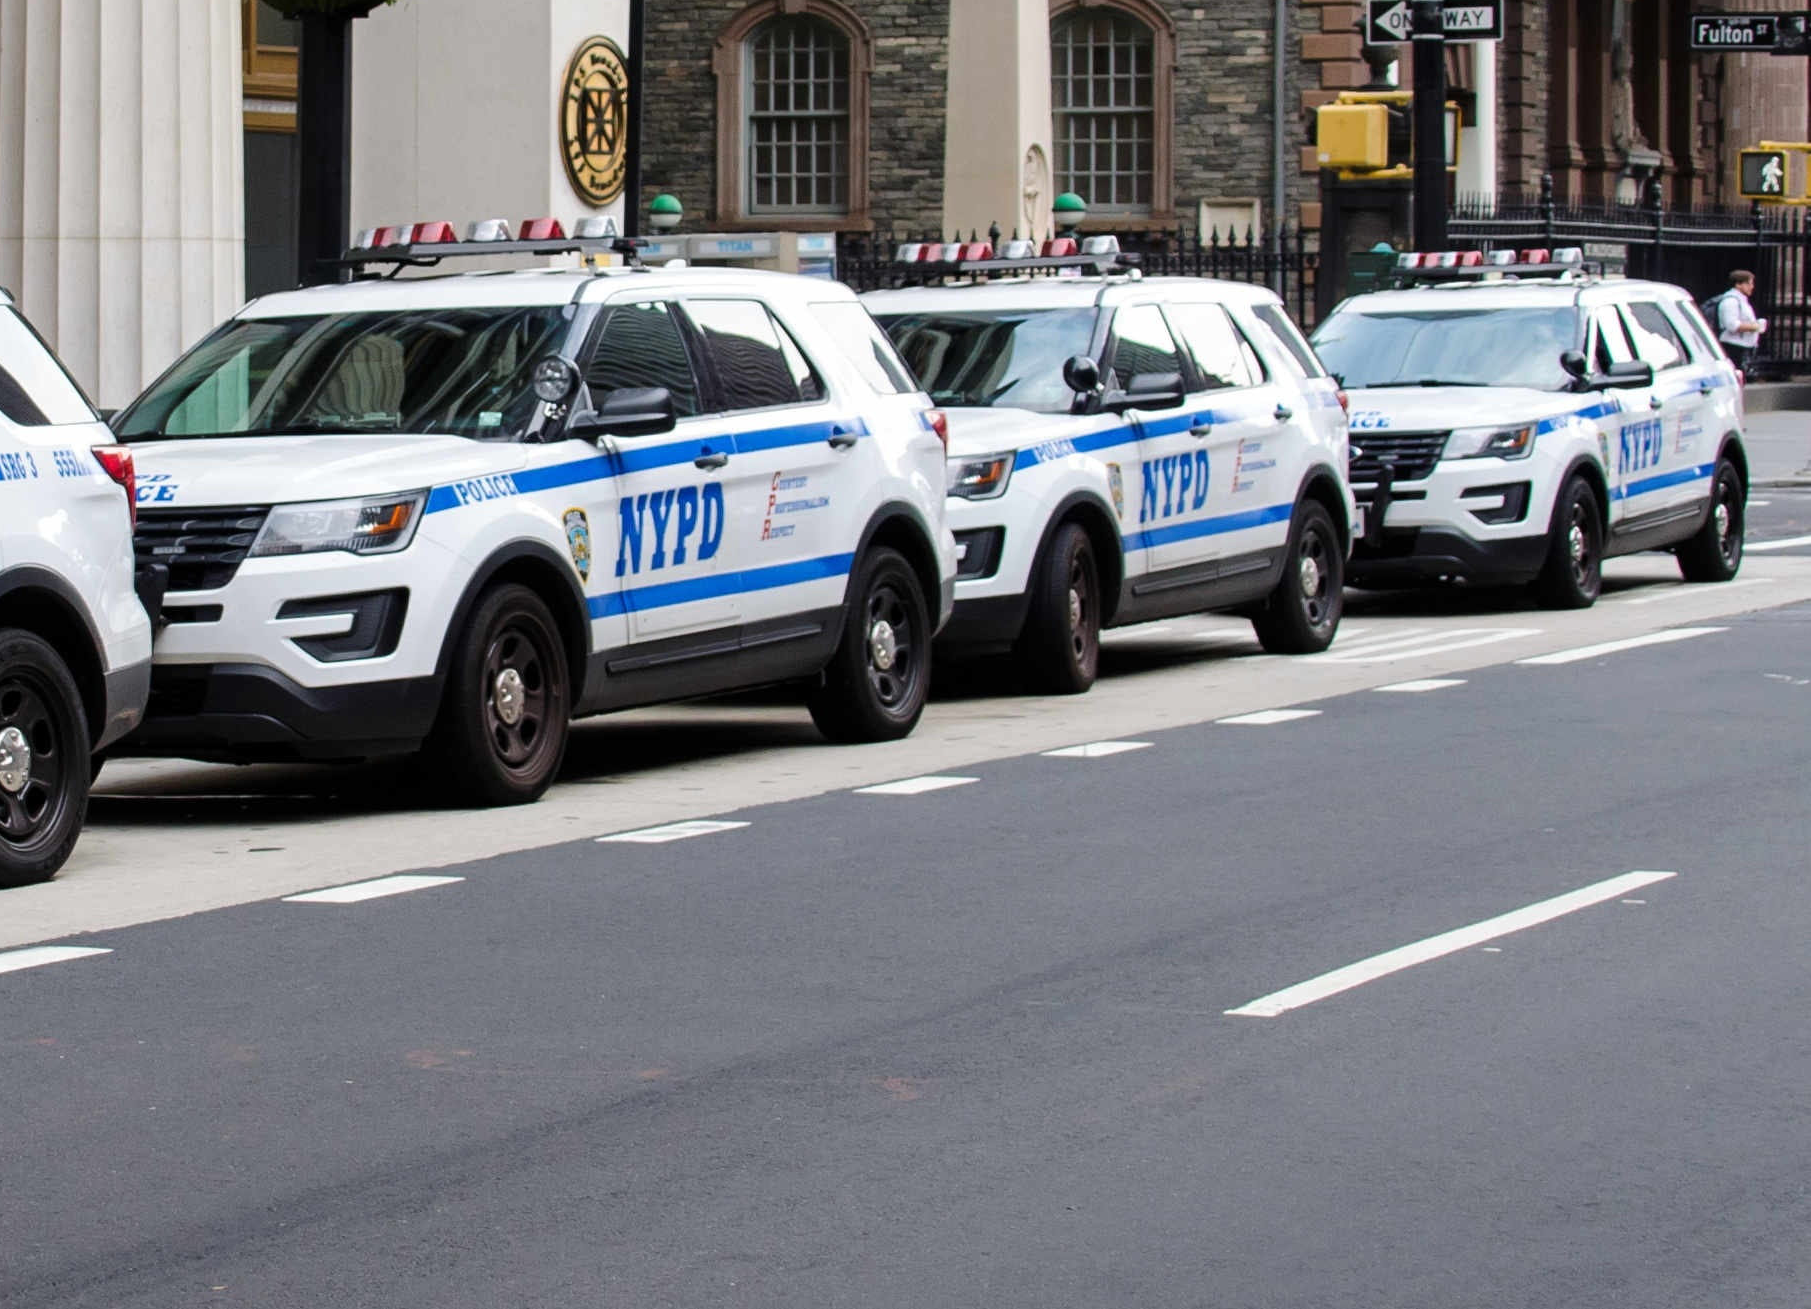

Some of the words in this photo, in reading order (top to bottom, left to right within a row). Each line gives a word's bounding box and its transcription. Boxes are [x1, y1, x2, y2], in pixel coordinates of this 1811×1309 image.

[1390, 9, 1412, 29] ON
[1443, 10, 1483, 28] WAY
[1698, 23, 1754, 43] Fulton
[1618, 417, 1663, 476] NYPD
[25, 451, 38, 479] 3
[454, 474, 518, 505] POLICE
[1140, 449, 1210, 524] NYPD
[614, 481, 725, 578] NYPD
